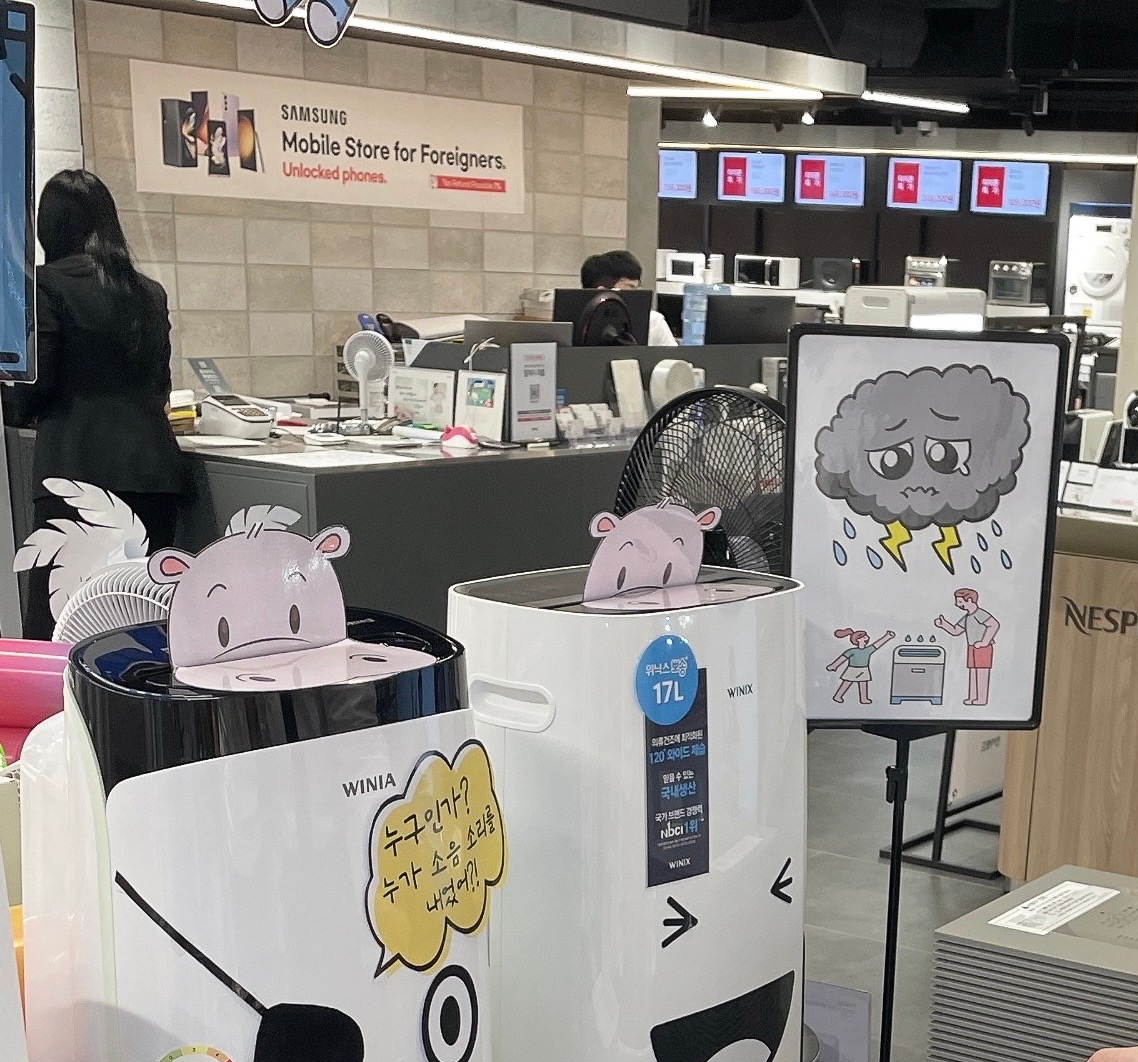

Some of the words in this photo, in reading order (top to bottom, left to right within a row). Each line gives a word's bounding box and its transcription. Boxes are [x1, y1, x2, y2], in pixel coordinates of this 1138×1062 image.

[281, 104, 347, 126] SAMSUNG
[282, 131, 340, 156] Mobile
[345, 137, 390, 160] Store
[394, 141, 416, 163] for
[421, 144, 506, 172] Foreigners.
[282, 162, 340, 181] Unlocked
[342, 167, 387, 185] phones.
[645, 662, 670, 677] 위닉스
[653, 680, 685, 705] 17L
[727, 683, 753, 699] WINIX
[342, 772, 397, 798] WINIA
[661, 780, 696, 799] 국내생산
[384, 776, 470, 857] 누구인가?
[382, 861, 423, 904] 누가
[431, 841, 461, 877] 소음
[466, 804, 496, 851] 소리를
[668, 857, 691, 869] WINIX
